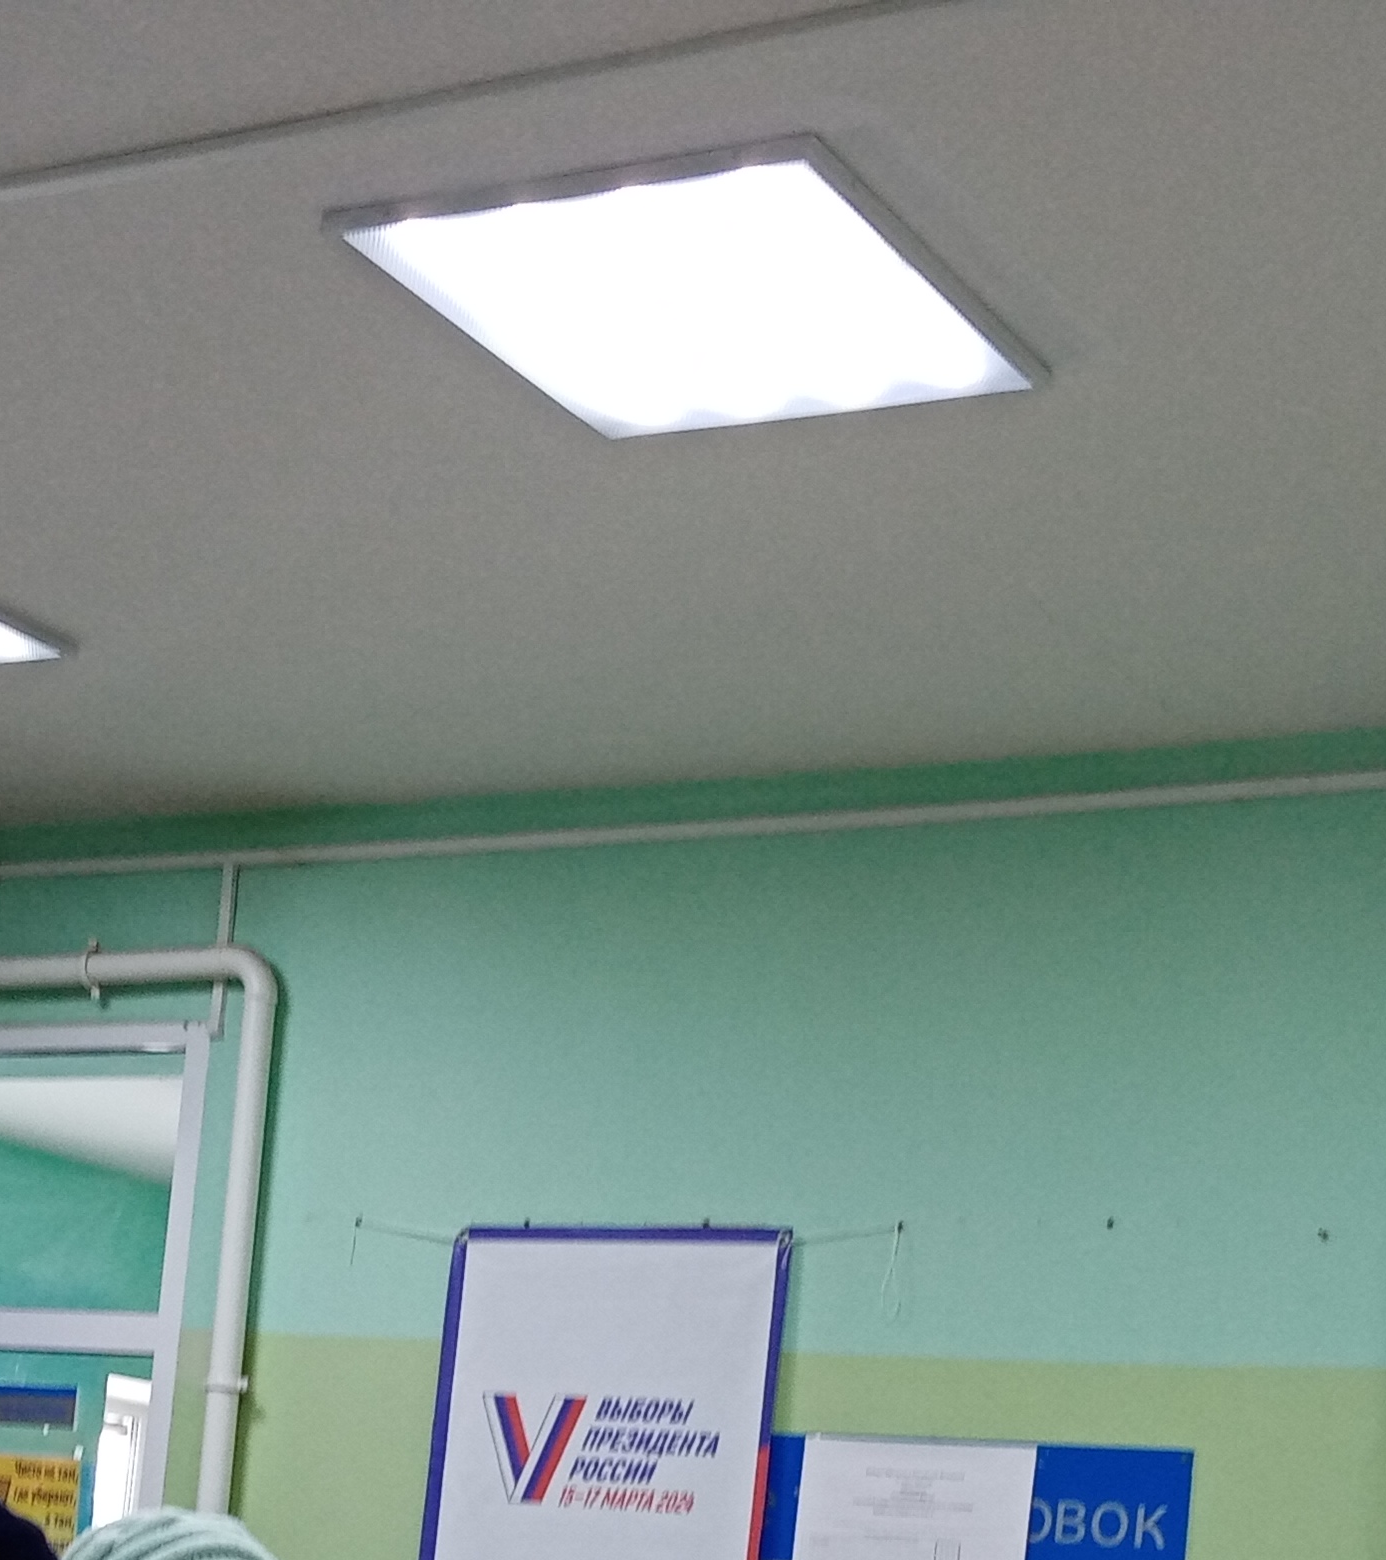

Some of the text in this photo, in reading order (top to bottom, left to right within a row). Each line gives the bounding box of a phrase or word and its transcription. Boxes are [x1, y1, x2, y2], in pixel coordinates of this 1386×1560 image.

[595, 1395, 695, 1425] ВЫБОРЫ
[582, 1425, 720, 1458] ПРЕЗИДЕНТА
[568, 1456, 660, 1484] РОССИИ
[600, 1487, 655, 1512] МАРТА
[655, 1491, 695, 1515] 2024
